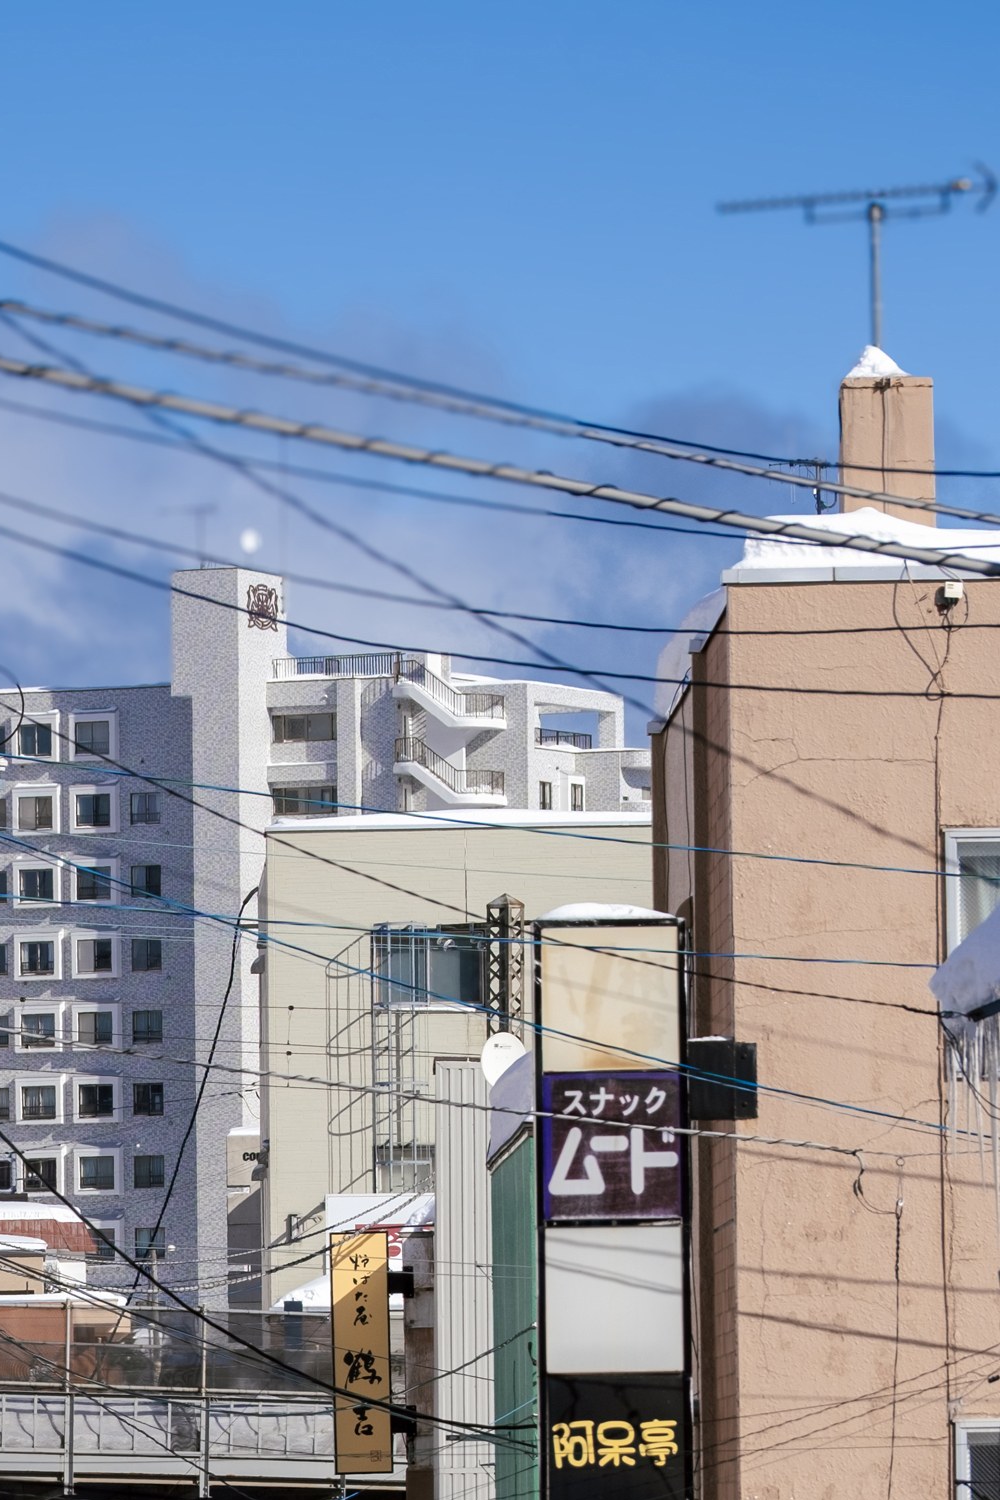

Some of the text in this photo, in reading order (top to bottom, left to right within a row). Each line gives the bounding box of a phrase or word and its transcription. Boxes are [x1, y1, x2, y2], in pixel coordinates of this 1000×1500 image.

[562, 1086, 667, 1116] スナック
[548, 1126, 679, 1195] ムード
[343, 1348, 382, 1436] 鶴吉
[552, 1419, 678, 1469] 阿呆亭
